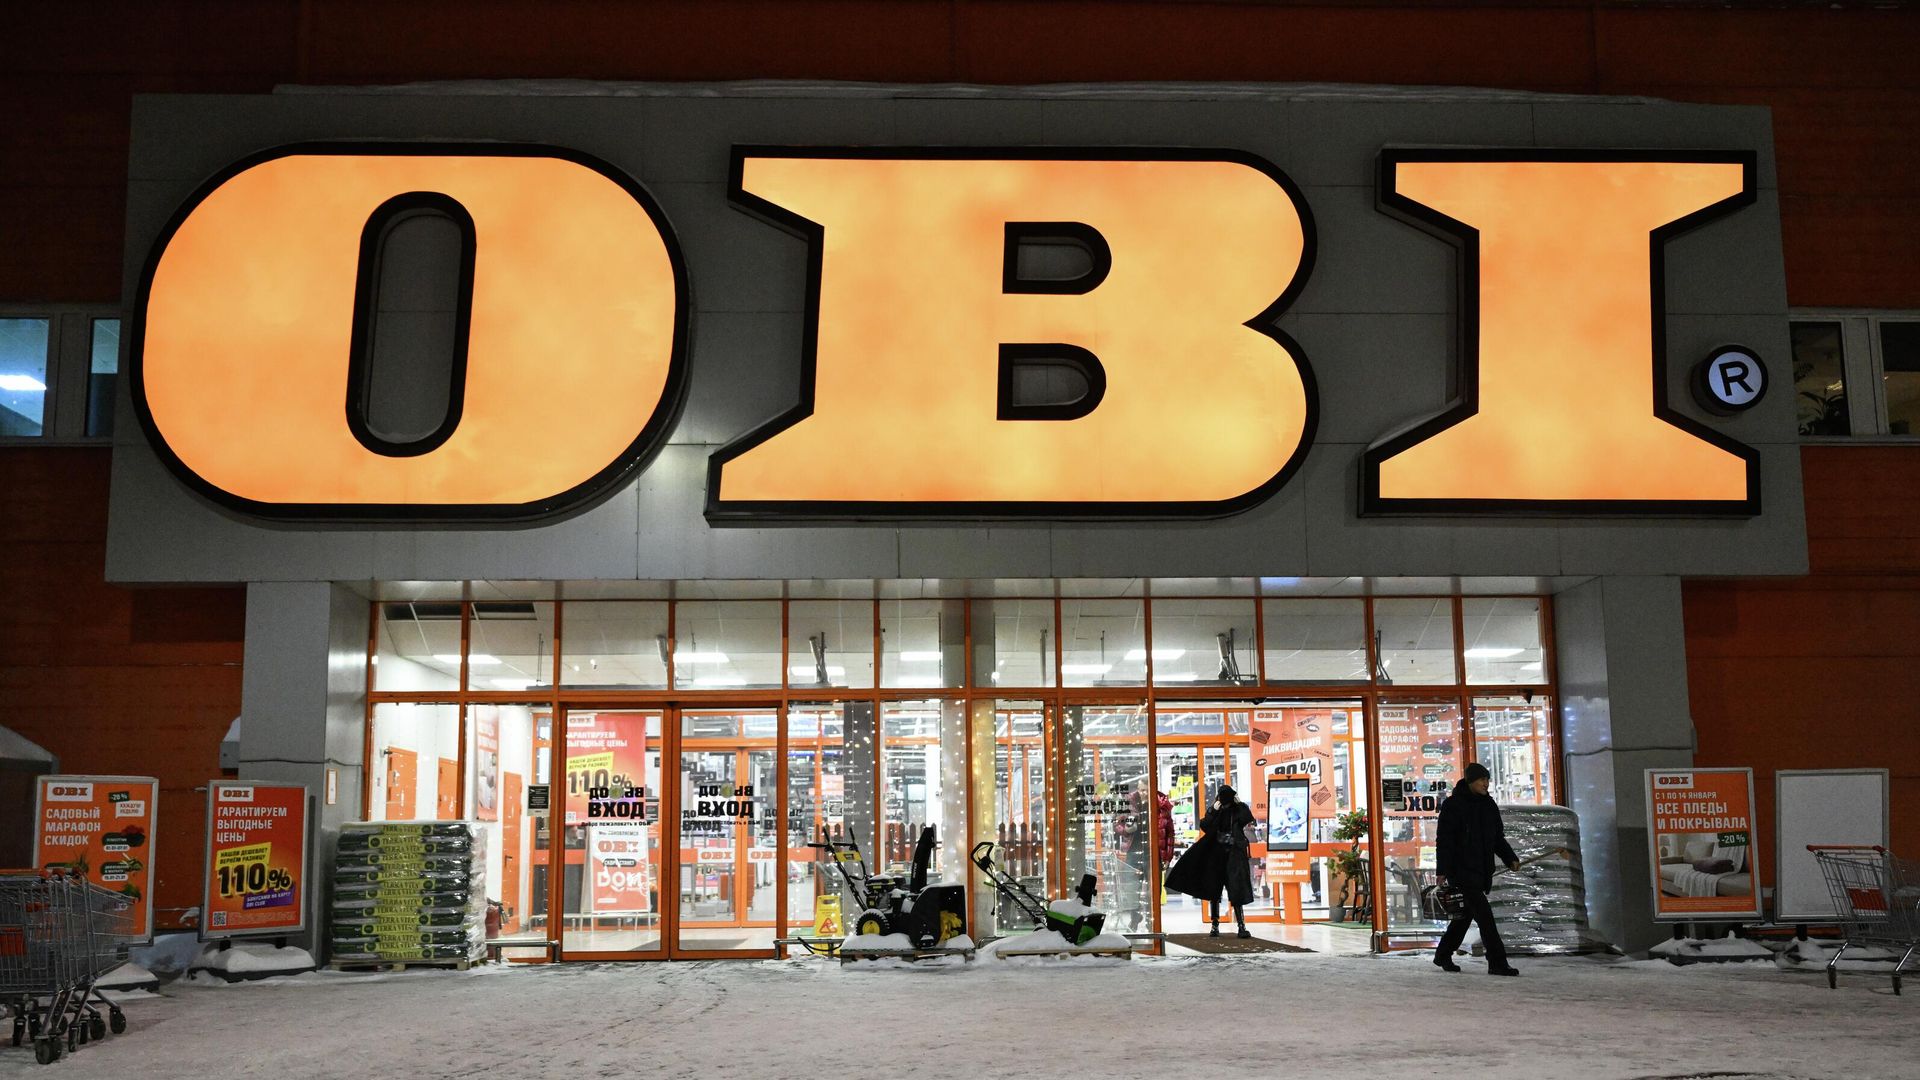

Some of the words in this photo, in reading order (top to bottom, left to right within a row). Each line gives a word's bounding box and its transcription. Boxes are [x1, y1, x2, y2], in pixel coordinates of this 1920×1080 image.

[131, 143, 1761, 525] OBI
[1380, 735, 1419, 743] МАРАФОН
[1262, 736, 1321, 755] ЛИКВИДАЦИЯ
[1380, 744, 1411, 753] СКИДОК
[1658, 776, 1689, 785] OBI
[52, 786, 88, 796] OBI
[223, 789, 250, 798] OBI
[1688, 791, 1717, 799] ЯНВАРЯ
[46, 806, 101, 820] САДОВЫЙ
[217, 806, 287, 817] ГАРАНТИРУЕМ
[588, 801, 645, 819] ВХОД
[698, 800, 754, 819] ВХОД
[1656, 802, 1680, 814] ВСЕ
[1683, 802, 1728, 815] ПЛЕДЫ
[45, 822, 101, 832] МАРАФОН
[217, 819, 273, 831] ВЫГОДНЫЕ
[1657, 818, 1666, 830] И
[1670, 817, 1747, 829] ПОКРЫВАЛА
[44, 835, 89, 847] СКИДОК
[216, 832, 246, 843] ЦЕНЫ
[598, 840, 639, 853] OBI
[701, 851, 731, 860] OBI
